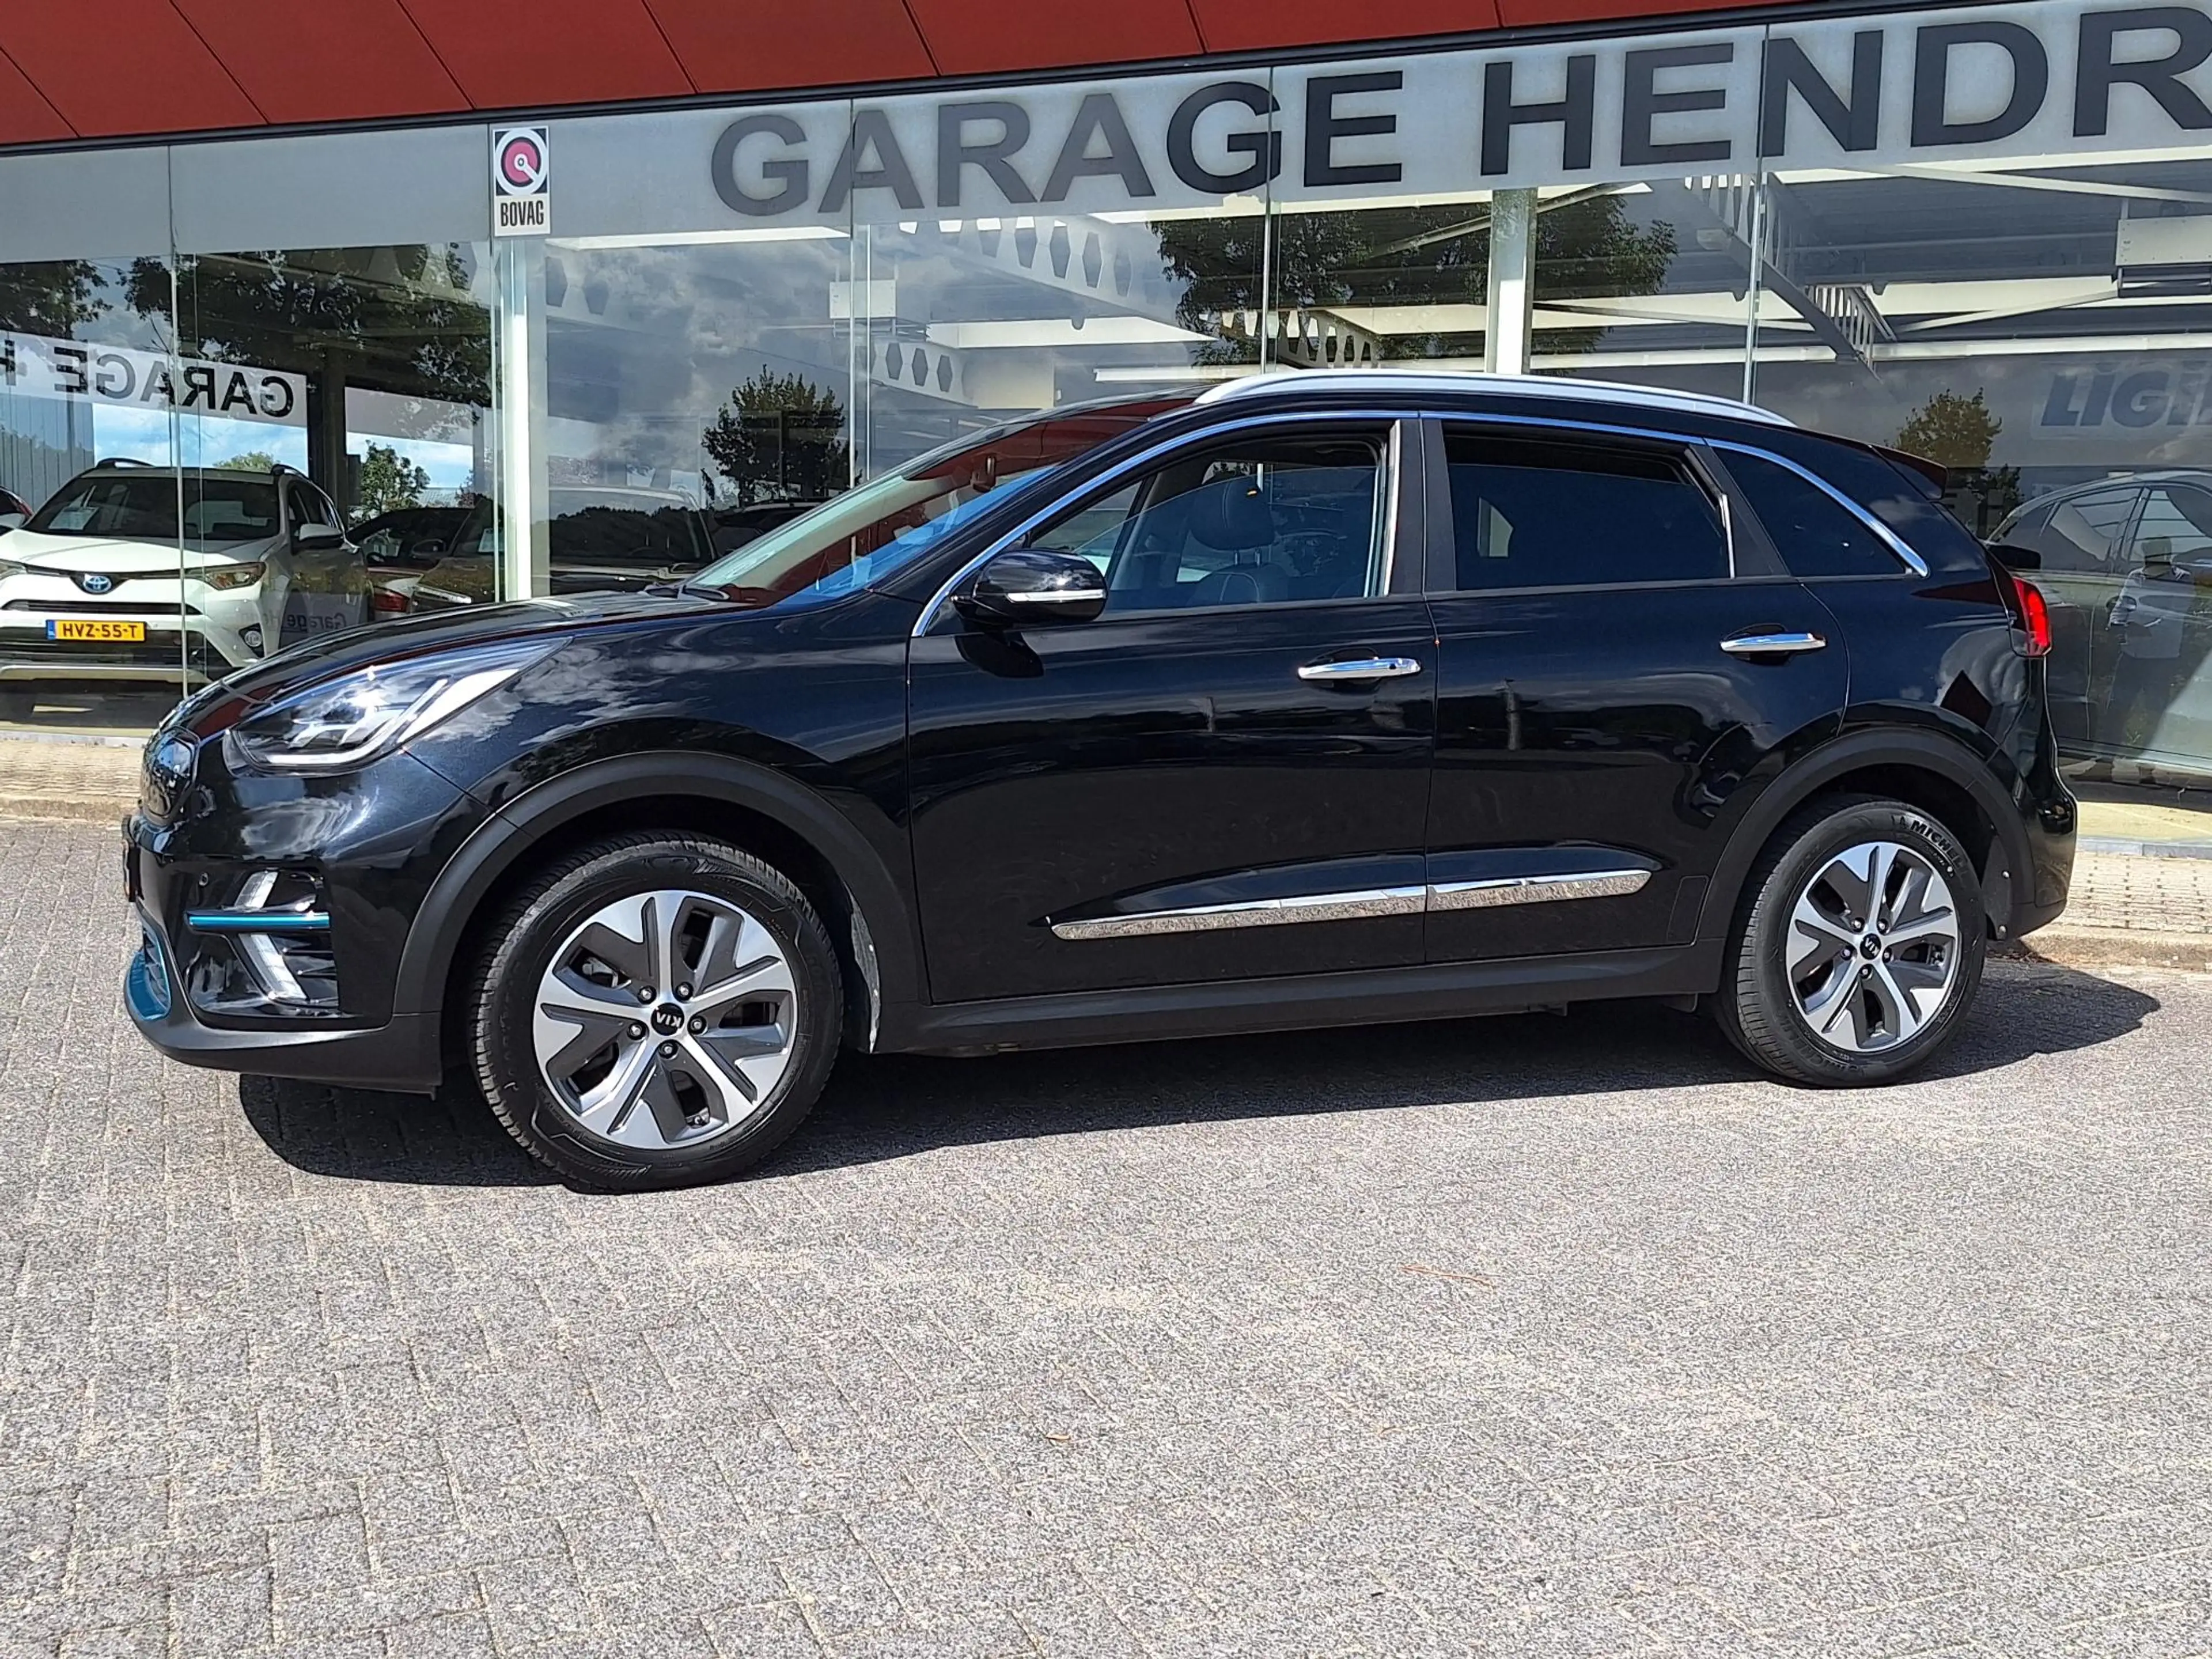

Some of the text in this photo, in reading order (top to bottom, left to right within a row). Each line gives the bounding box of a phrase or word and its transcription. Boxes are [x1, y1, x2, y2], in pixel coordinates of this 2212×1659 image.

[711, 70, 1403, 217] GARAGE
[501, 200, 544, 226] BOVAG
[62, 623, 138, 638] HVZ-55-T
[657, 1012, 681, 1028] KIA
